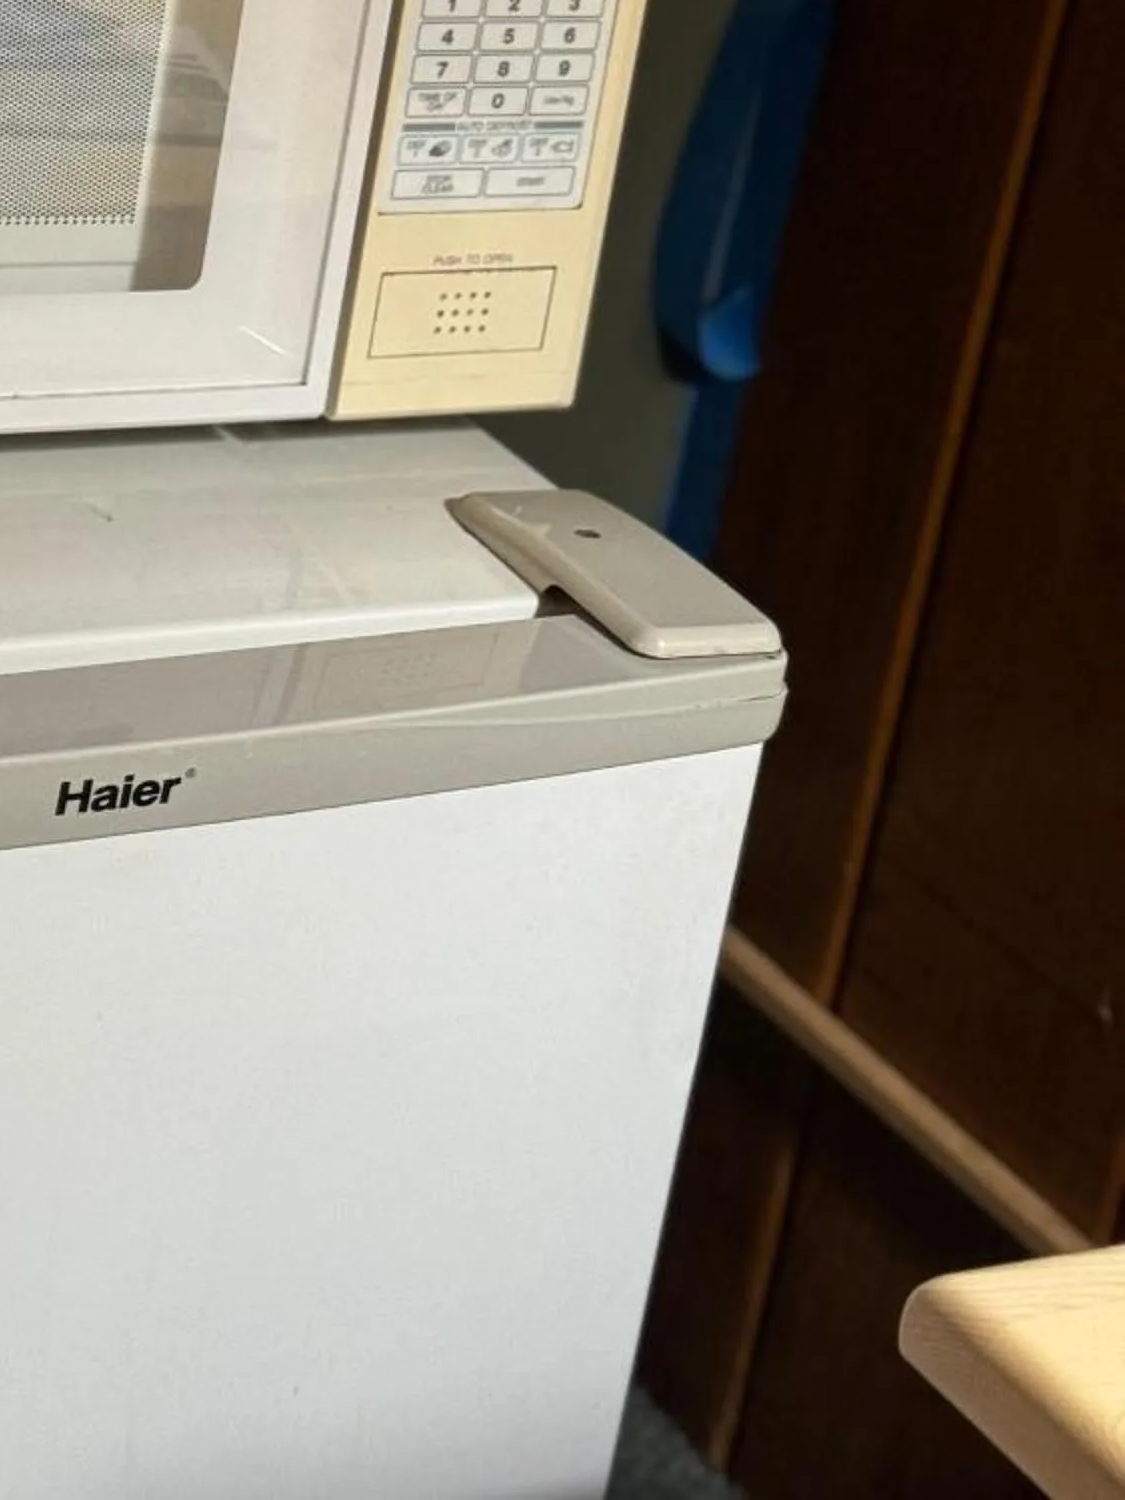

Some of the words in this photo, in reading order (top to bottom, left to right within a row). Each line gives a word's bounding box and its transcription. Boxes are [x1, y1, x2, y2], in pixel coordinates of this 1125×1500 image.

[441, 28, 454, 44] 4
[503, 28, 515, 44] 5
[563, 27, 575, 43] 6
[436, 62, 449, 78] 7
[497, 61, 510, 77] 8
[558, 60, 571, 76] 9
[492, 93, 504, 109] 0
[55, 774, 182, 816] Haier
